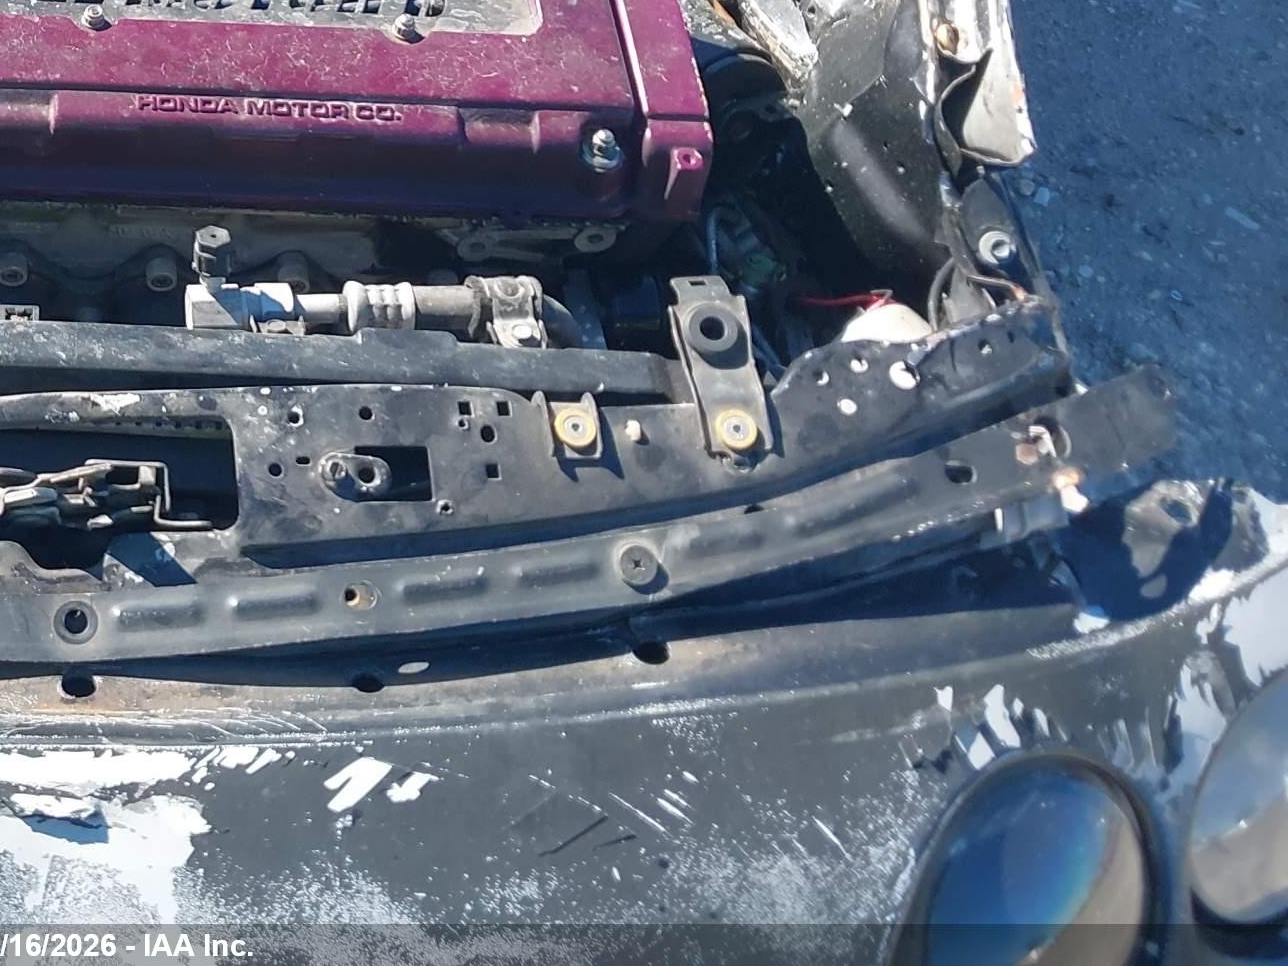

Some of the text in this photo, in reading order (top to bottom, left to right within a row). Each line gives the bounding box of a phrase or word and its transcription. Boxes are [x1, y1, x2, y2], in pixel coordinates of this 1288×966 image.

[136, 95, 403, 123] HONDA MOTOR CO.
